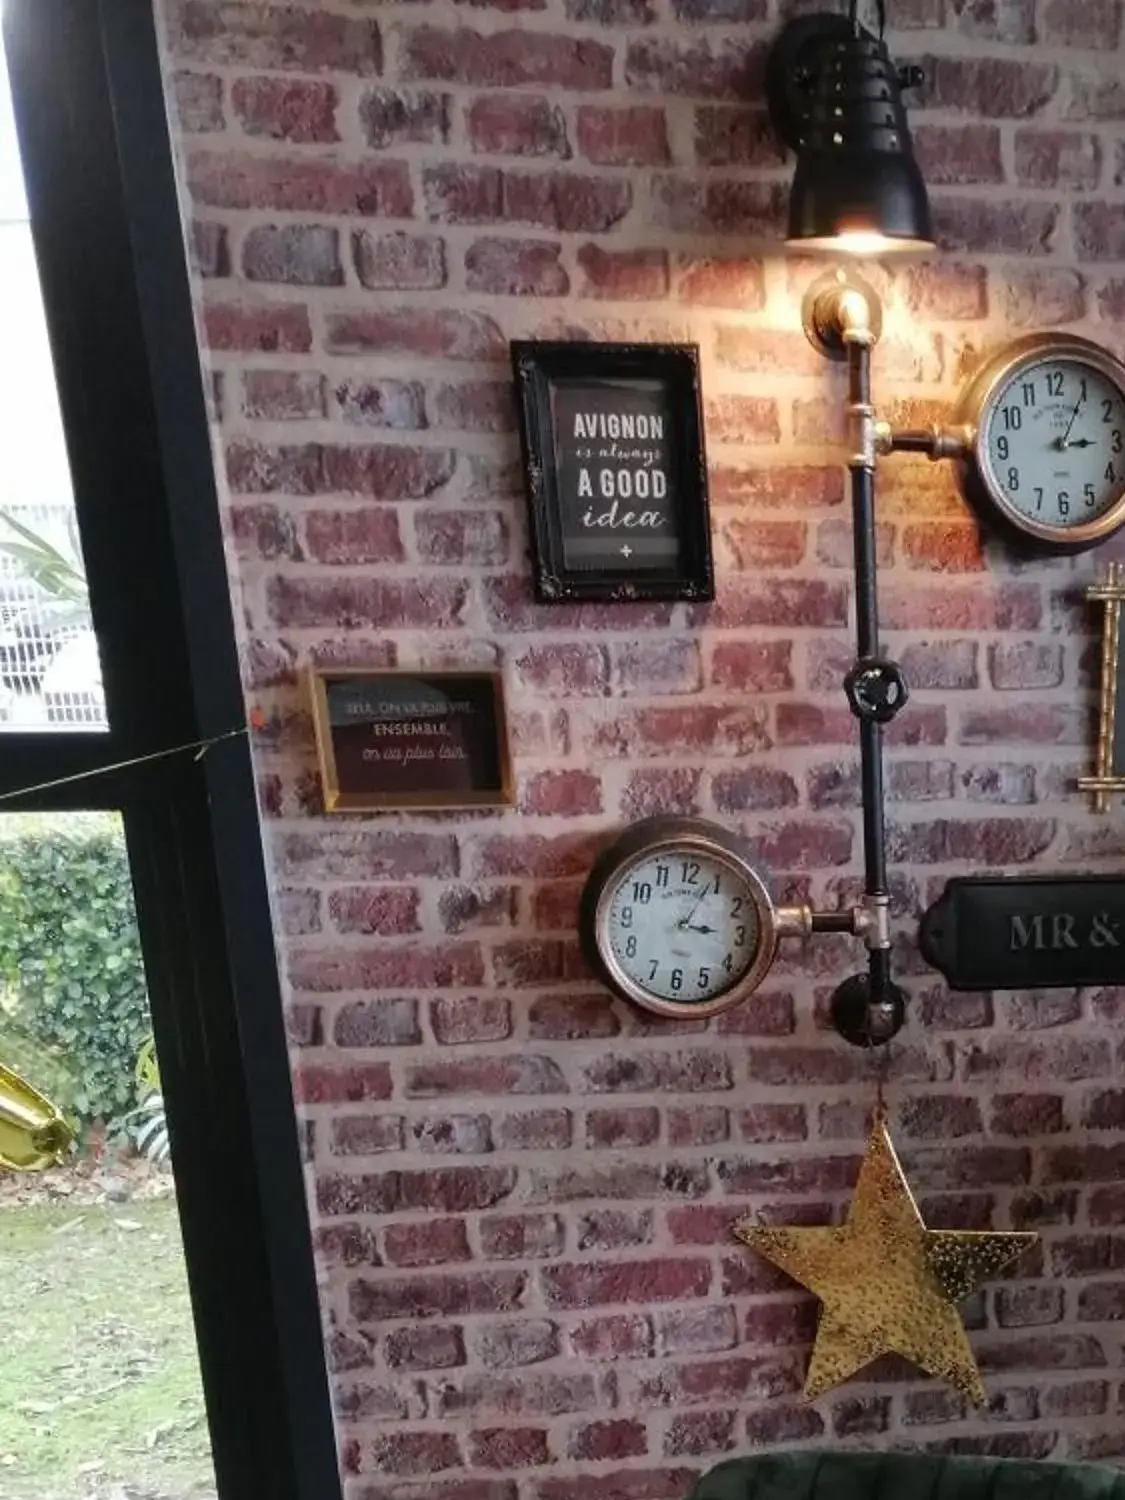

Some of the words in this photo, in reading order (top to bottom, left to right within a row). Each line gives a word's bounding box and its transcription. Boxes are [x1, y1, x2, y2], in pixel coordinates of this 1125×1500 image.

[1021, 382, 1036, 407] 11
[1046, 371, 1064, 397] 12
[1079, 377, 1088, 400] 1
[1002, 406, 1021, 430] 10
[1101, 399, 1113, 423] 2
[574, 413, 664, 439] AVIGNON
[997, 436, 1009, 460] 9
[1111, 429, 1123, 453] 3
[599, 442, 662, 467] always
[577, 467, 594, 497] A
[599, 467, 668, 498] GOOD
[1008, 467, 1020, 491] 8
[1104, 462, 1115, 484] 4
[1033, 488, 1043, 511] 7
[1057, 491, 1069, 516] 6
[1084, 483, 1095, 507] 5
[583, 499, 667, 529] idea
[656, 865, 669, 888] 11
[681, 862, 700, 885] 12
[713, 874, 721, 894] 1
[633, 881, 651, 904] 10
[620, 906, 633, 928] 9
[730, 897, 742, 918] 2
[734, 925, 745, 946] 3
[1010, 913, 1079, 950] MR
[1089, 910, 1121, 948] &
[625, 936, 637, 958] 8
[649, 959, 660, 981] 7
[722, 952, 733, 973] 4
[671, 968, 683, 990] 6
[697, 968, 711, 989] 5
